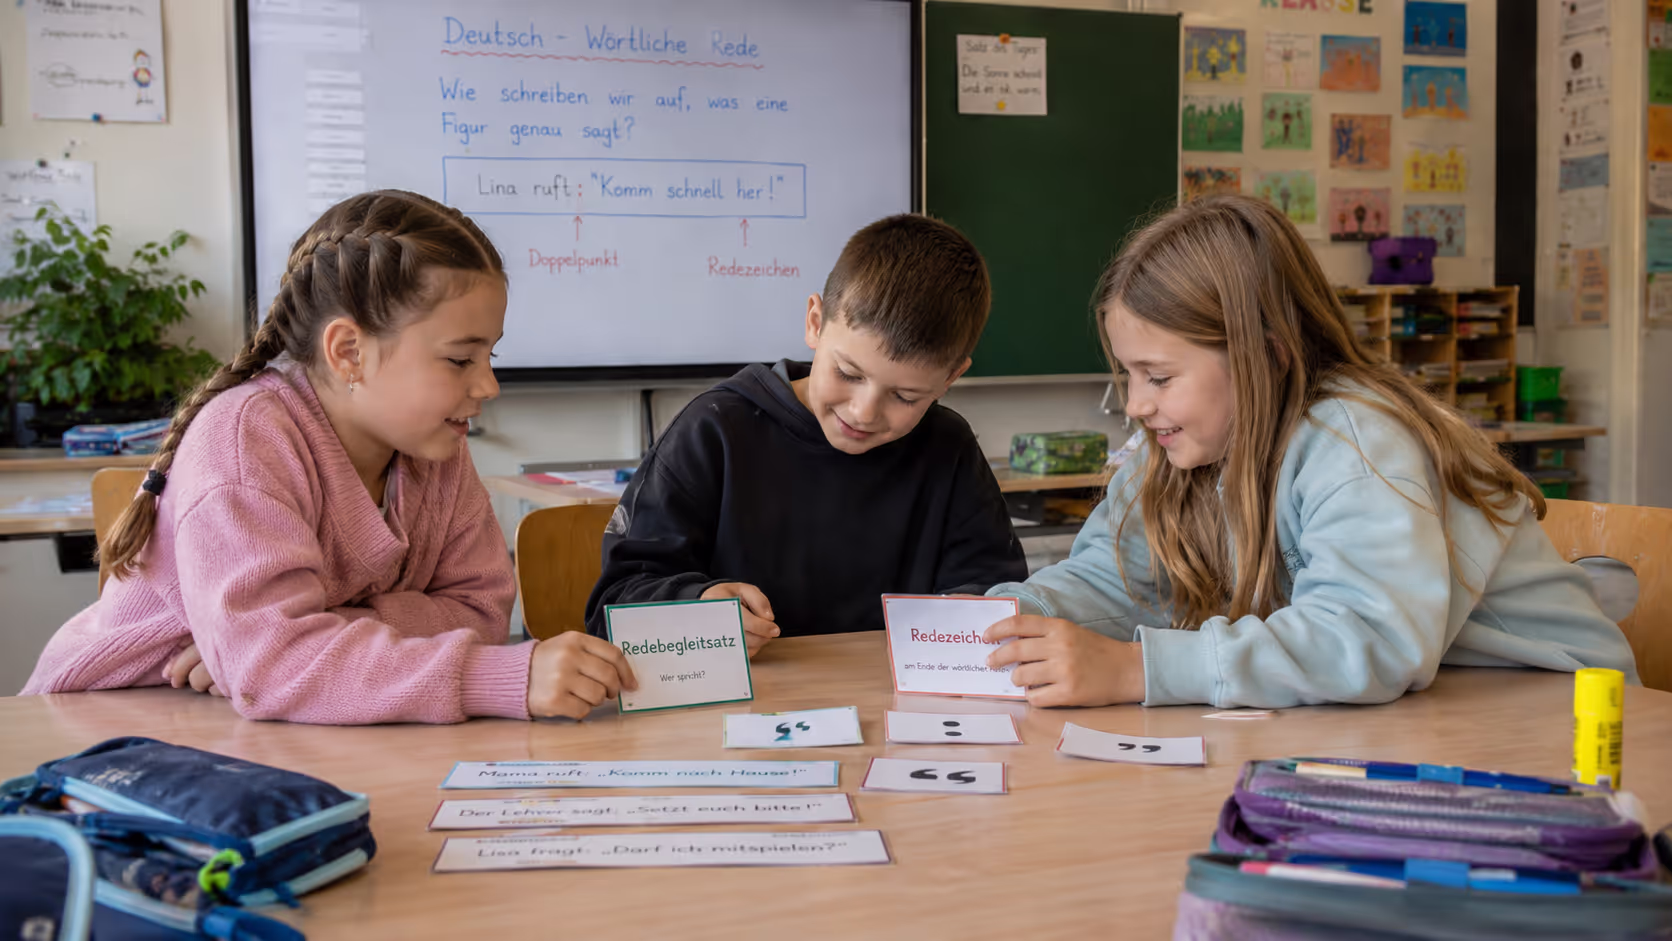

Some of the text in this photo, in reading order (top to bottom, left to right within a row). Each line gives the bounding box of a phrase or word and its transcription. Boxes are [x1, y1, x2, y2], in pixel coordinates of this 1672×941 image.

[442, 16, 544, 48] Deutsch
[584, 24, 687, 54] Wörtliche
[710, 29, 760, 58] Rede
[438, 76, 789, 112] Wie schreiben wir auf, was eine
[442, 111, 635, 149] Figur genau sagt?
[477, 173, 518, 196] Lina
[666, 177, 725, 200] schnell
[528, 248, 801, 278] Doppelpunkt Redezeichen
[621, 634, 737, 656] Redebegleitsatz
[917, 662, 936, 671] Ende
[937, 662, 949, 671] der
[659, 673, 675, 683] Wer
[478, 770, 539, 778] Mama
[676, 769, 723, 777] nach
[458, 808, 497, 818] Der
[697, 804, 746, 813] euch
[477, 848, 521, 858] Lisa
[671, 843, 703, 854] ich
